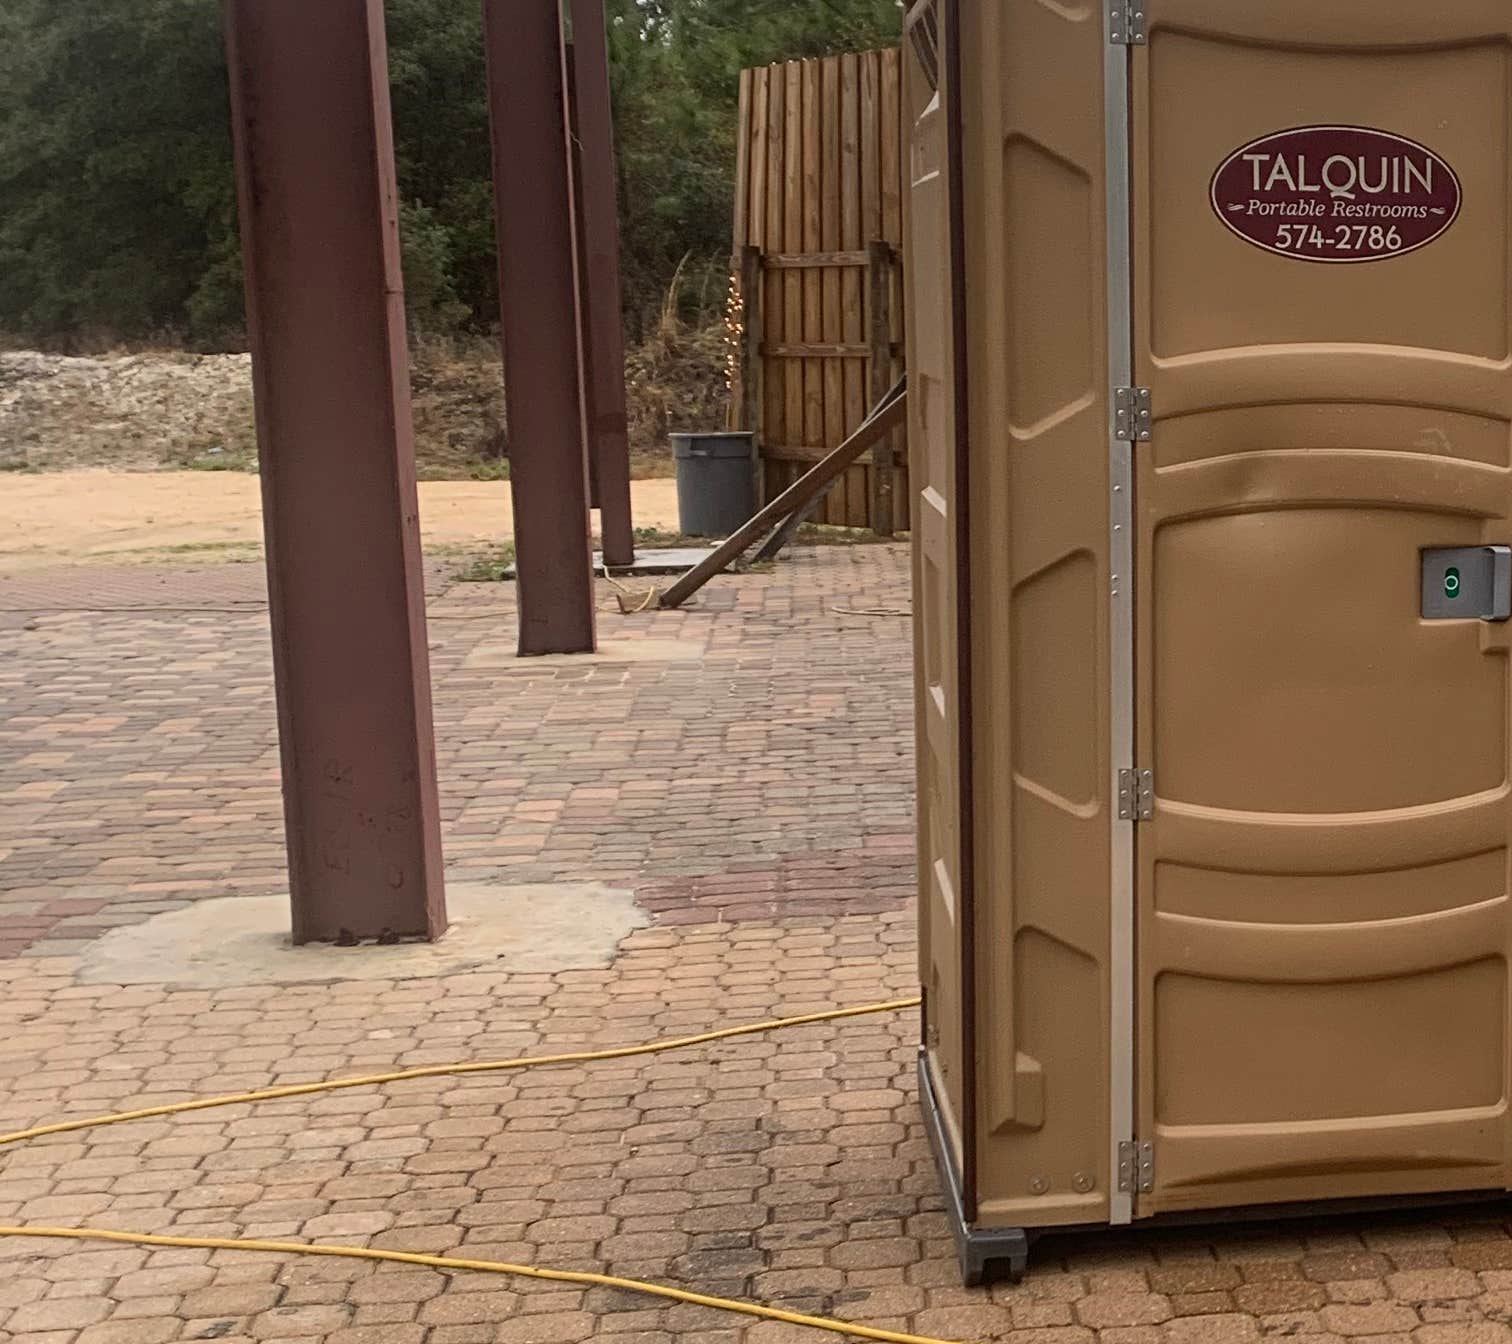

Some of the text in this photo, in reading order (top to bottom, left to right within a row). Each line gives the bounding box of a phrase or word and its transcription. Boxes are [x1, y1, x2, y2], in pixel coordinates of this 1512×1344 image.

[1242, 152, 1433, 200] TALQUIN
[1246, 199, 1428, 219] Portable Restrooms
[1274, 224, 1402, 250] 574-2786
